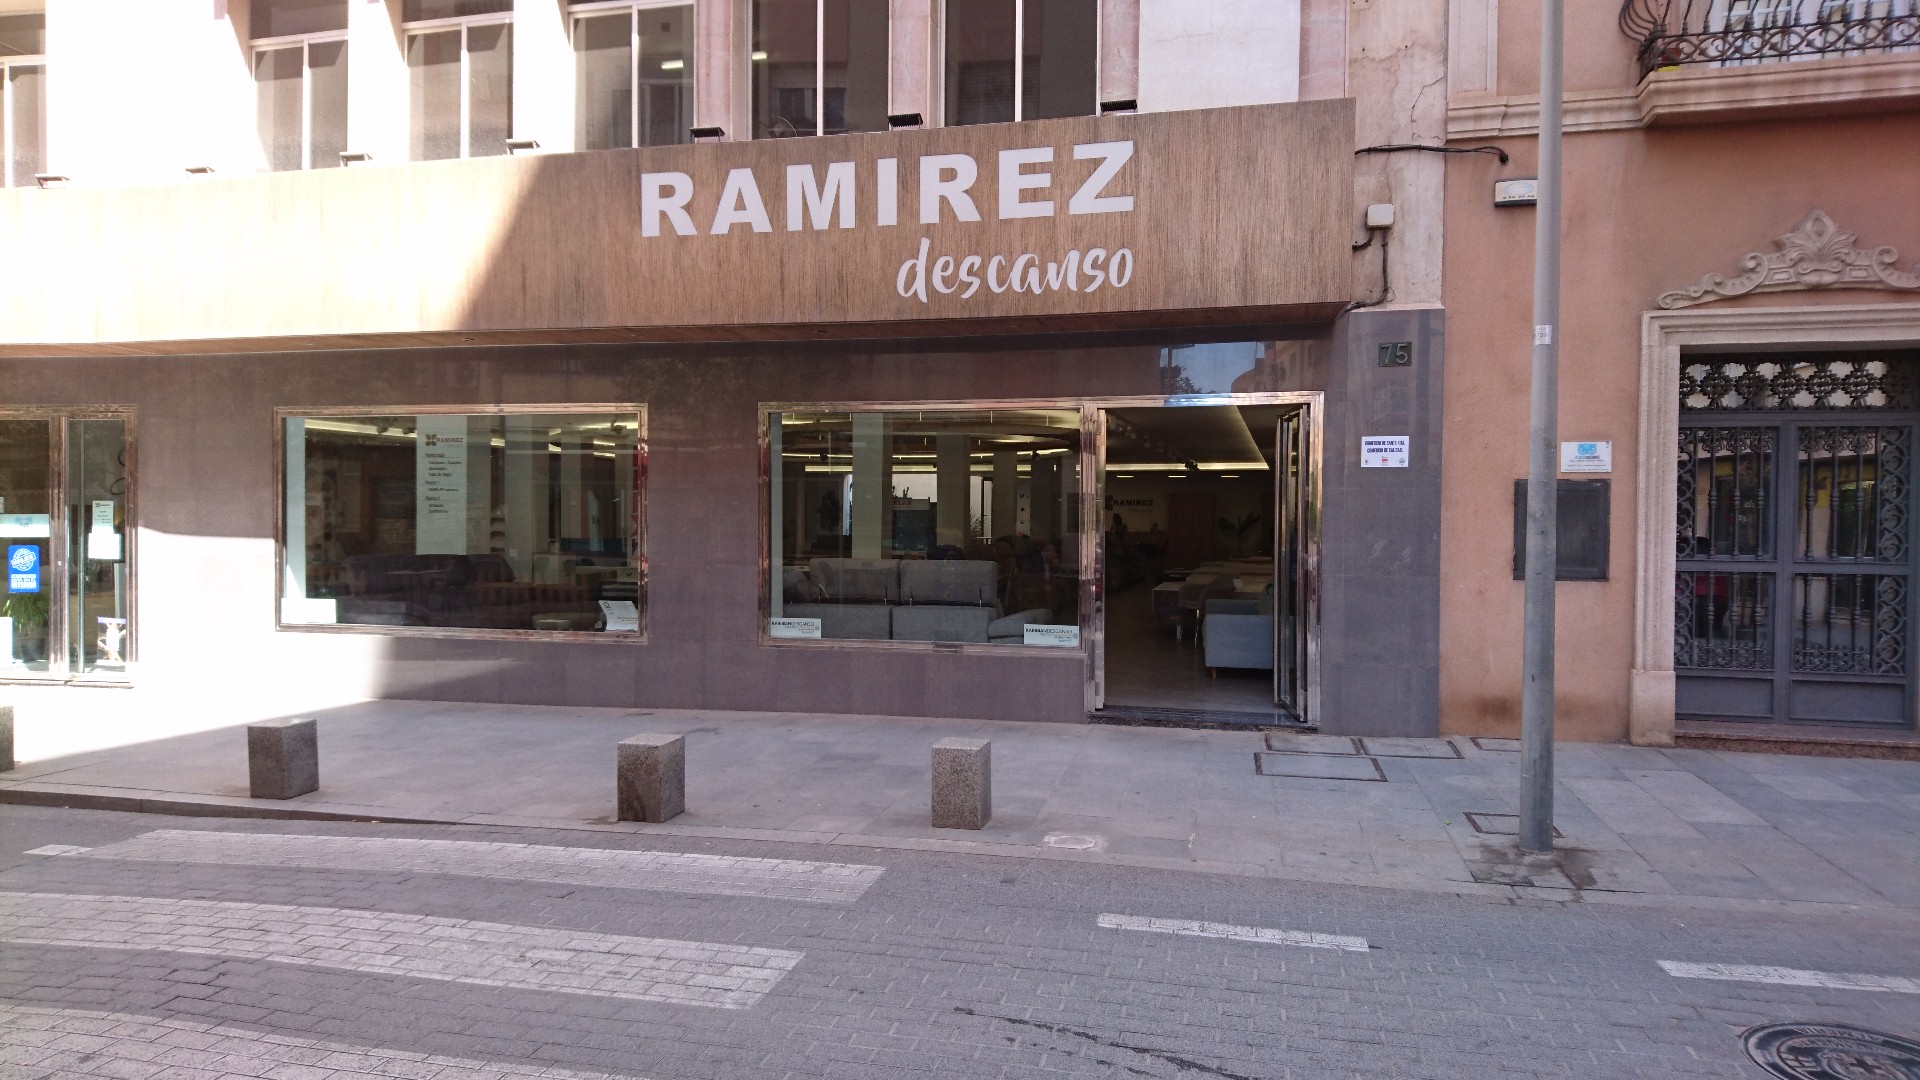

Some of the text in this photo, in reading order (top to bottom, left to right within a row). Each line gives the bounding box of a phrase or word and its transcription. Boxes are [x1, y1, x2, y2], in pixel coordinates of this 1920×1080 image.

[642, 140, 1134, 238] RAMIREZ
[896, 237, 1133, 302] descanso
[1381, 343, 1408, 365] 75
